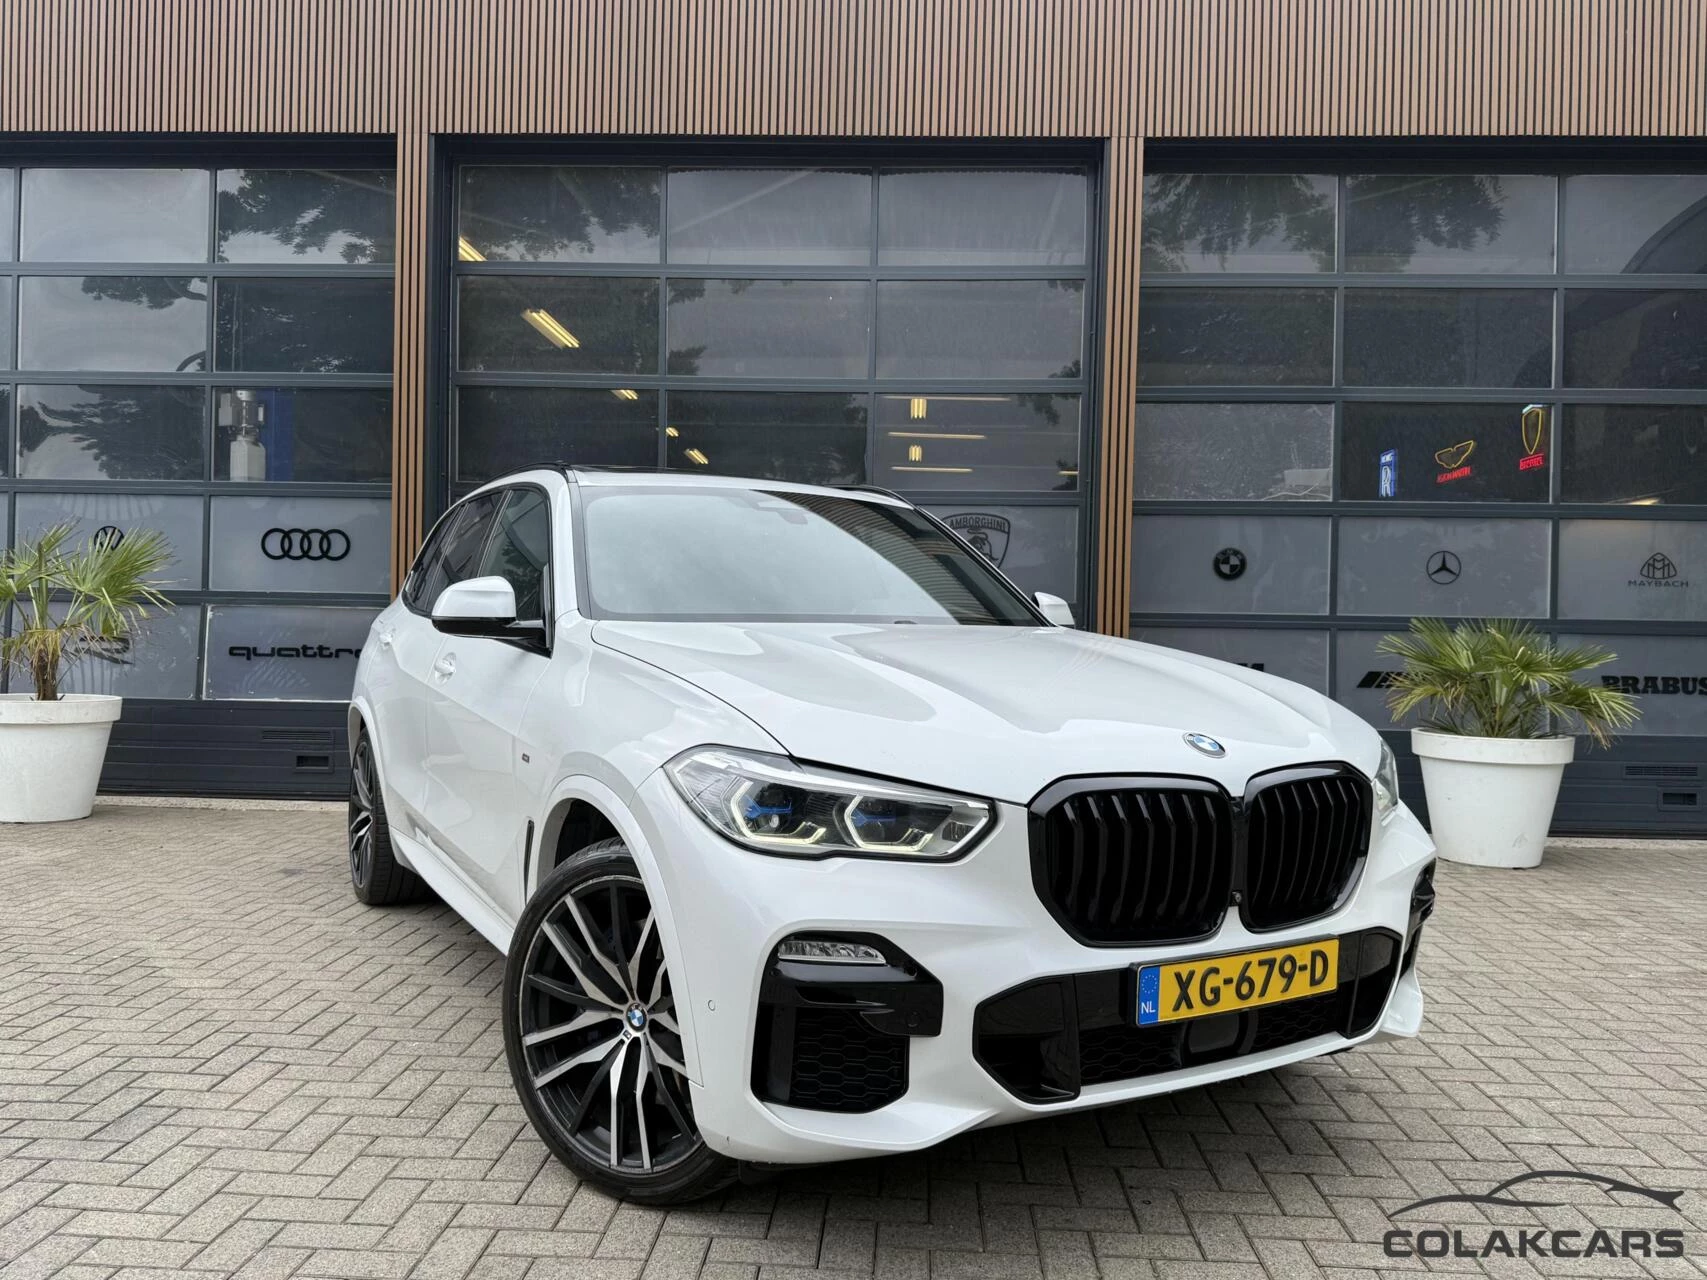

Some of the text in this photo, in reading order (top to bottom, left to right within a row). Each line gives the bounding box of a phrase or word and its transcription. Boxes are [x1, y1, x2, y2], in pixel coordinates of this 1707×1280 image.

[949, 516, 1007, 532] AMBORGHINI
[1627, 579, 1689, 588] MAYBACH
[1172, 949, 1329, 1012] XG-679-D
[1141, 1001, 1156, 1015] NL
